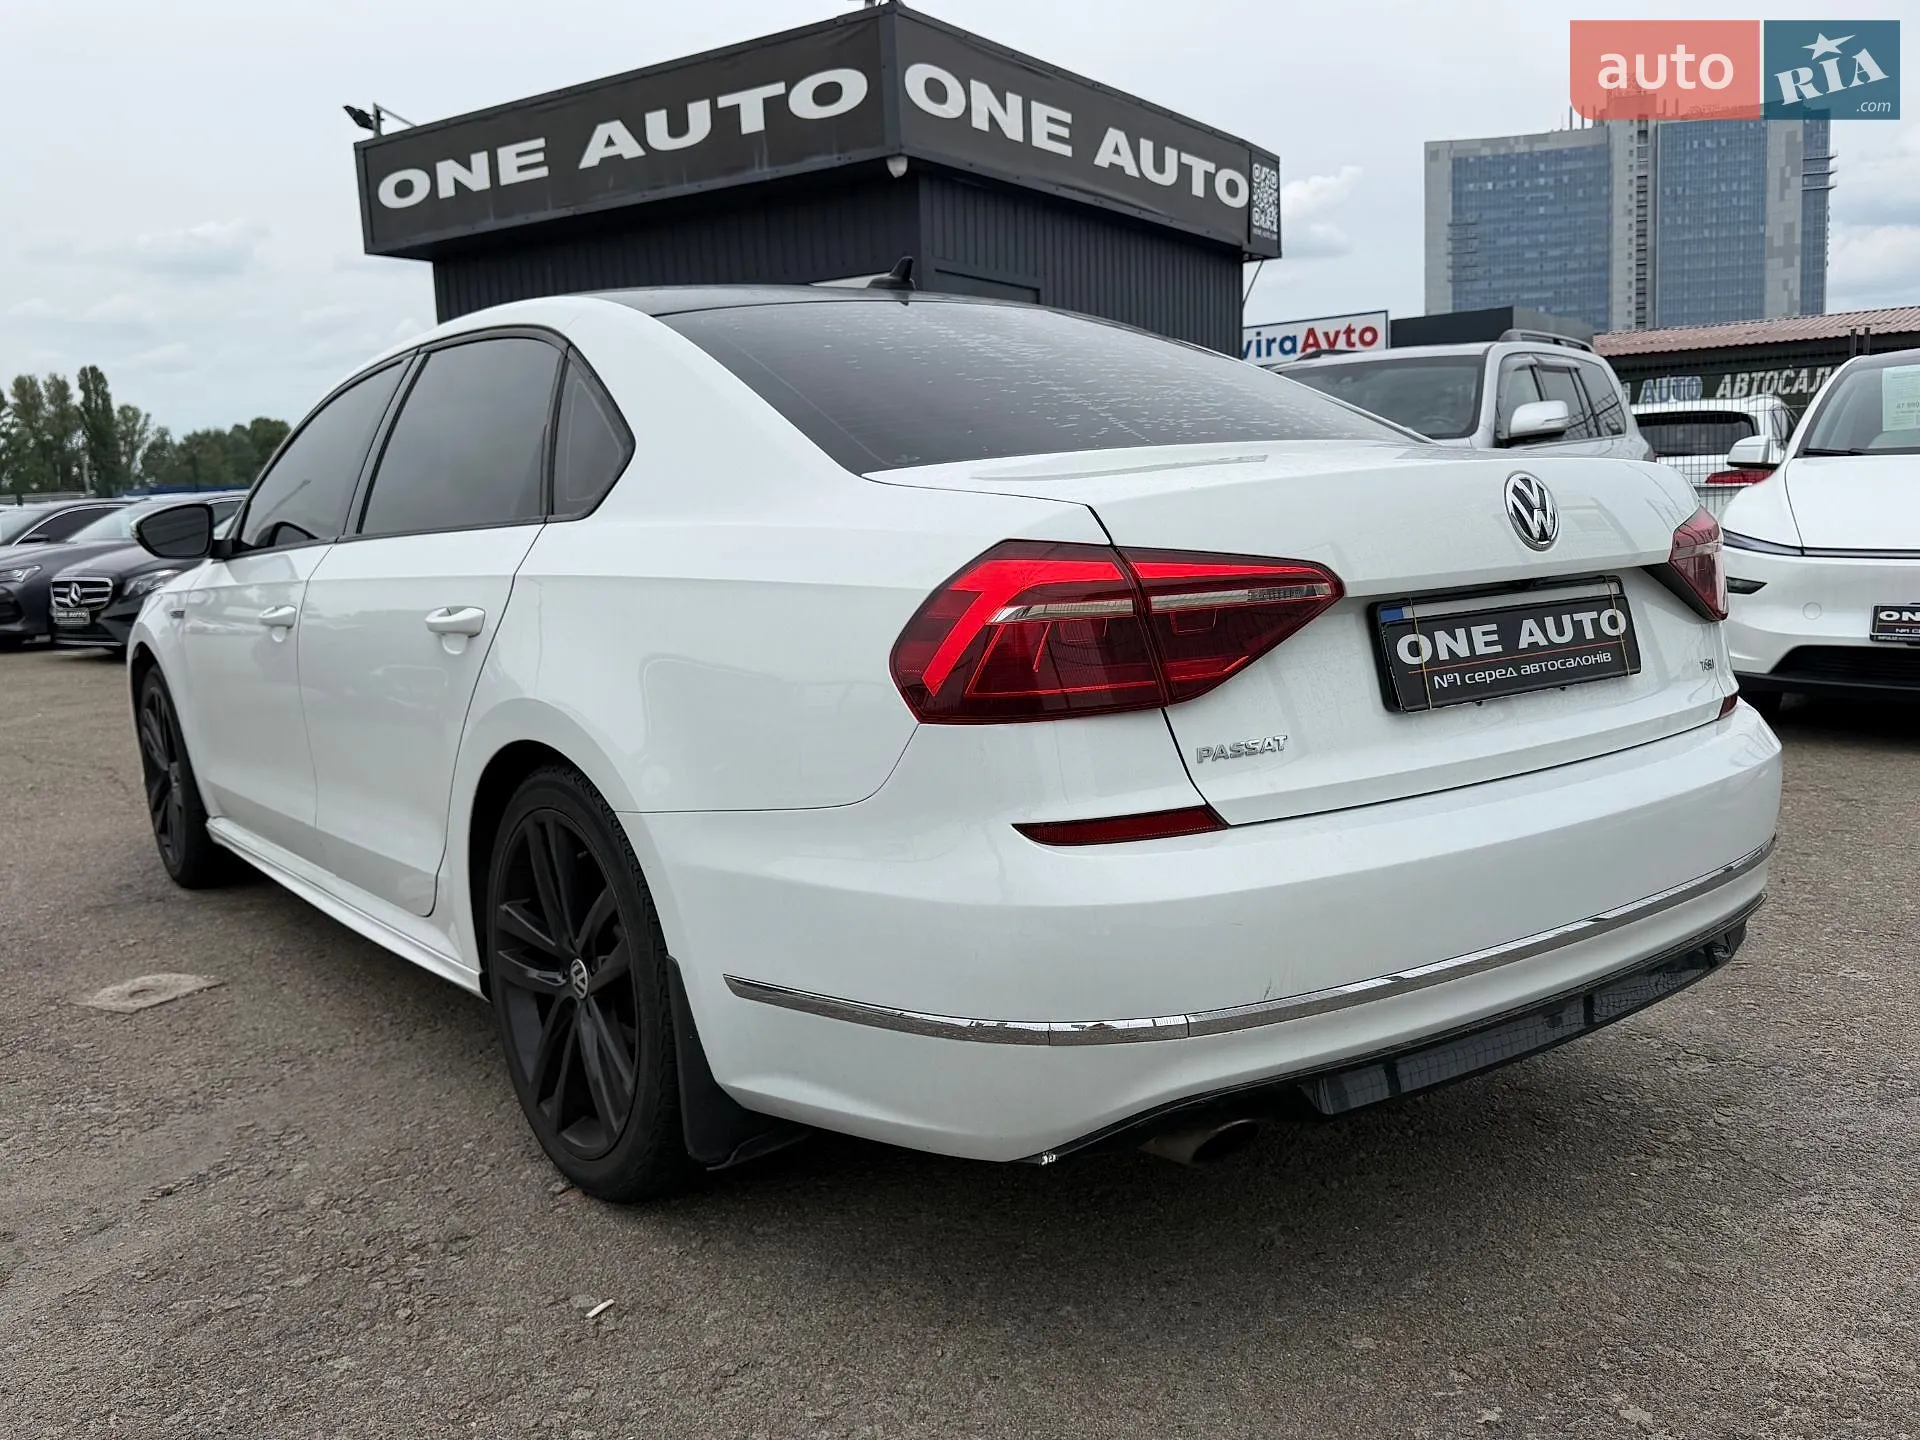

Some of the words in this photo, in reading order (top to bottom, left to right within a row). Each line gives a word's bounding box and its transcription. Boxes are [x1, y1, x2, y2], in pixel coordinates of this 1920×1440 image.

[377, 137, 549, 209] ONE
[578, 68, 868, 170] AUTO
[904, 63, 1072, 158] ONE
[1093, 127, 1250, 208] AUTO
[1715, 366, 1841, 399] АВТОСАЛ
[1396, 624, 1503, 665] ONE
[1518, 608, 1627, 650] AUTO
[1433, 673, 1461, 690] №1
[1465, 667, 1517, 684] серед
[1520, 650, 1612, 676] автосалонів
[1196, 735, 1288, 764] PASSAT
